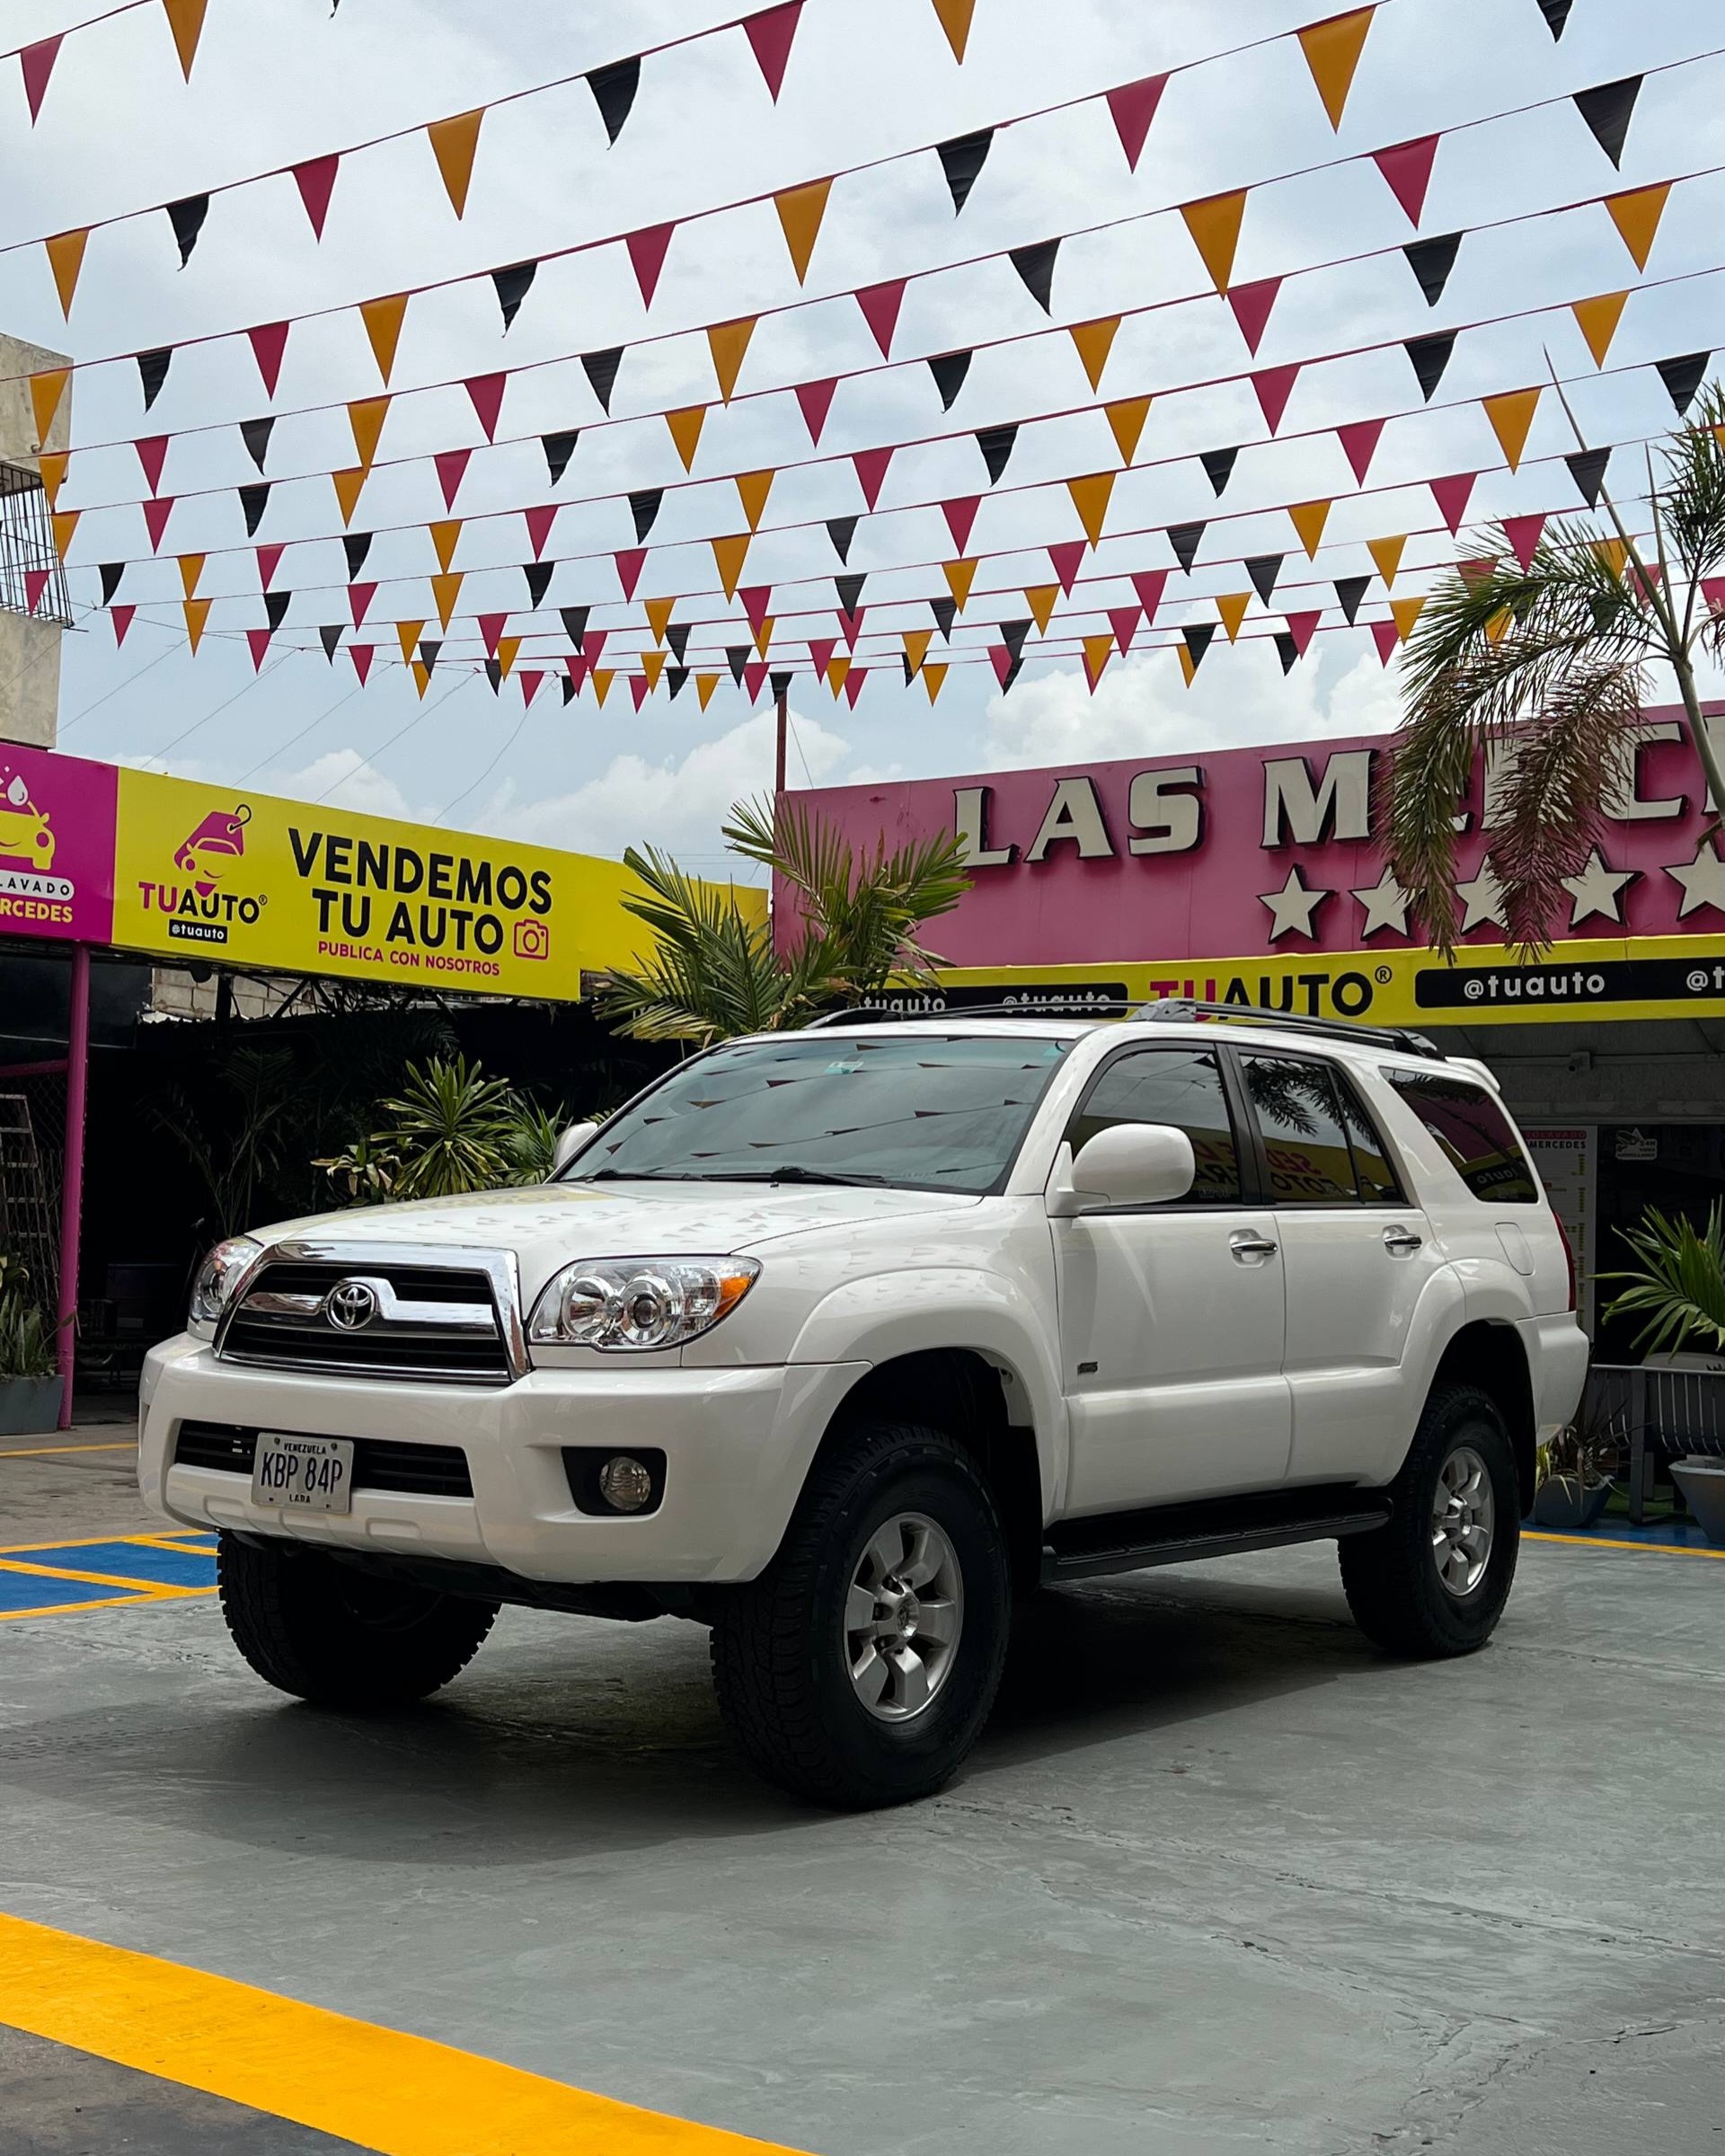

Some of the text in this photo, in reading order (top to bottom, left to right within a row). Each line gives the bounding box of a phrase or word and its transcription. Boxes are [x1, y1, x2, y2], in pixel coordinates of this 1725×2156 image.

[953, 765, 1204, 868] LAS
[288, 827, 553, 915] VENDEMOS
[0, 877, 70, 896] AVADO
[172, 924, 225, 941] @tuauto
[312, 888, 504, 955] TU AUTO
[318, 941, 500, 976] PUBLICA CON NOSOTROS
[1464, 971, 1606, 1000] @tuauto
[857, 995, 946, 1013] tuauto
[1002, 991, 1111, 1014] @tuauto
[1529, 1141, 1587, 1150] MERCEDES
[283, 1443, 327, 1455] VENEZUELA
[261, 1452, 344, 1495] KBP 84P
